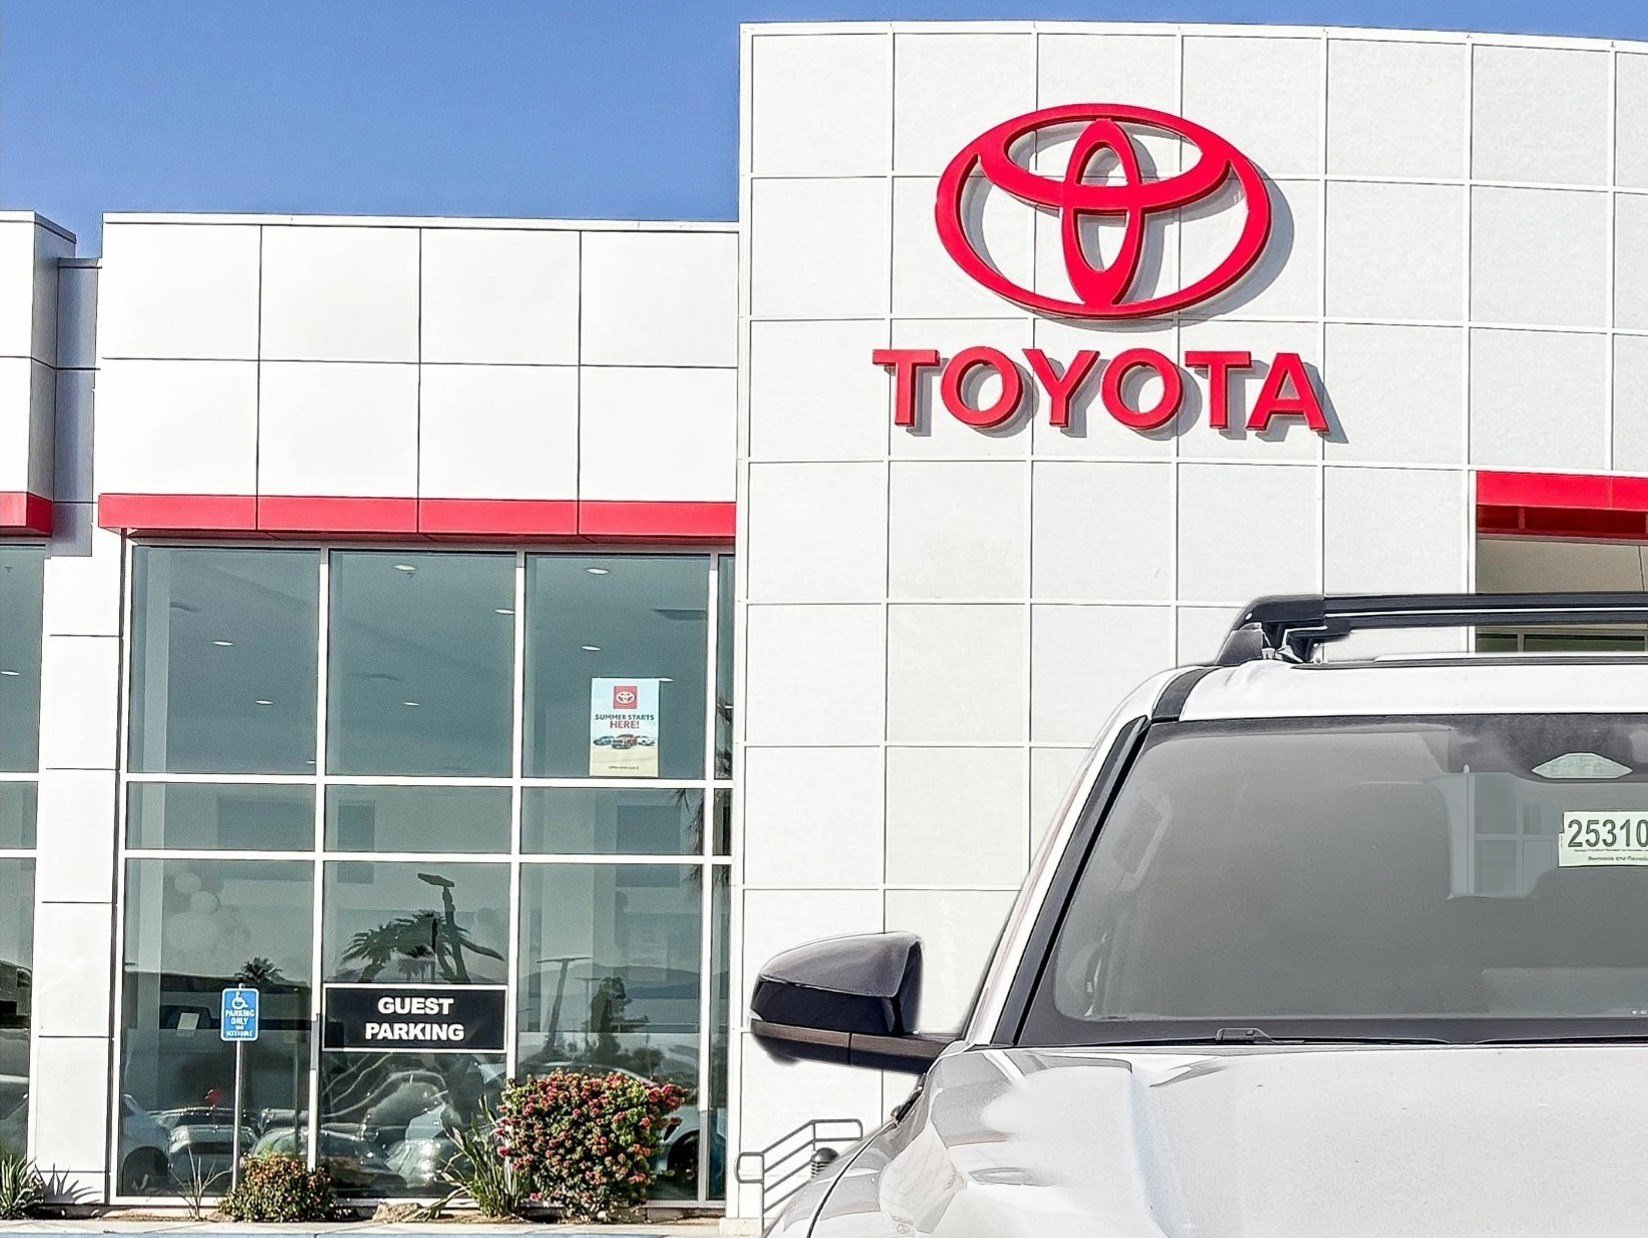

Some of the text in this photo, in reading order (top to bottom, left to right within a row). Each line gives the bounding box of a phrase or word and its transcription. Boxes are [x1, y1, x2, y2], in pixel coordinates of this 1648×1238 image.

[873, 346, 1330, 433] TOYOTA
[610, 720, 640, 728] HERE!
[225, 1009, 255, 1017] PARKING
[377, 997, 454, 1014] GUEST
[365, 1023, 464, 1040] PARKING
